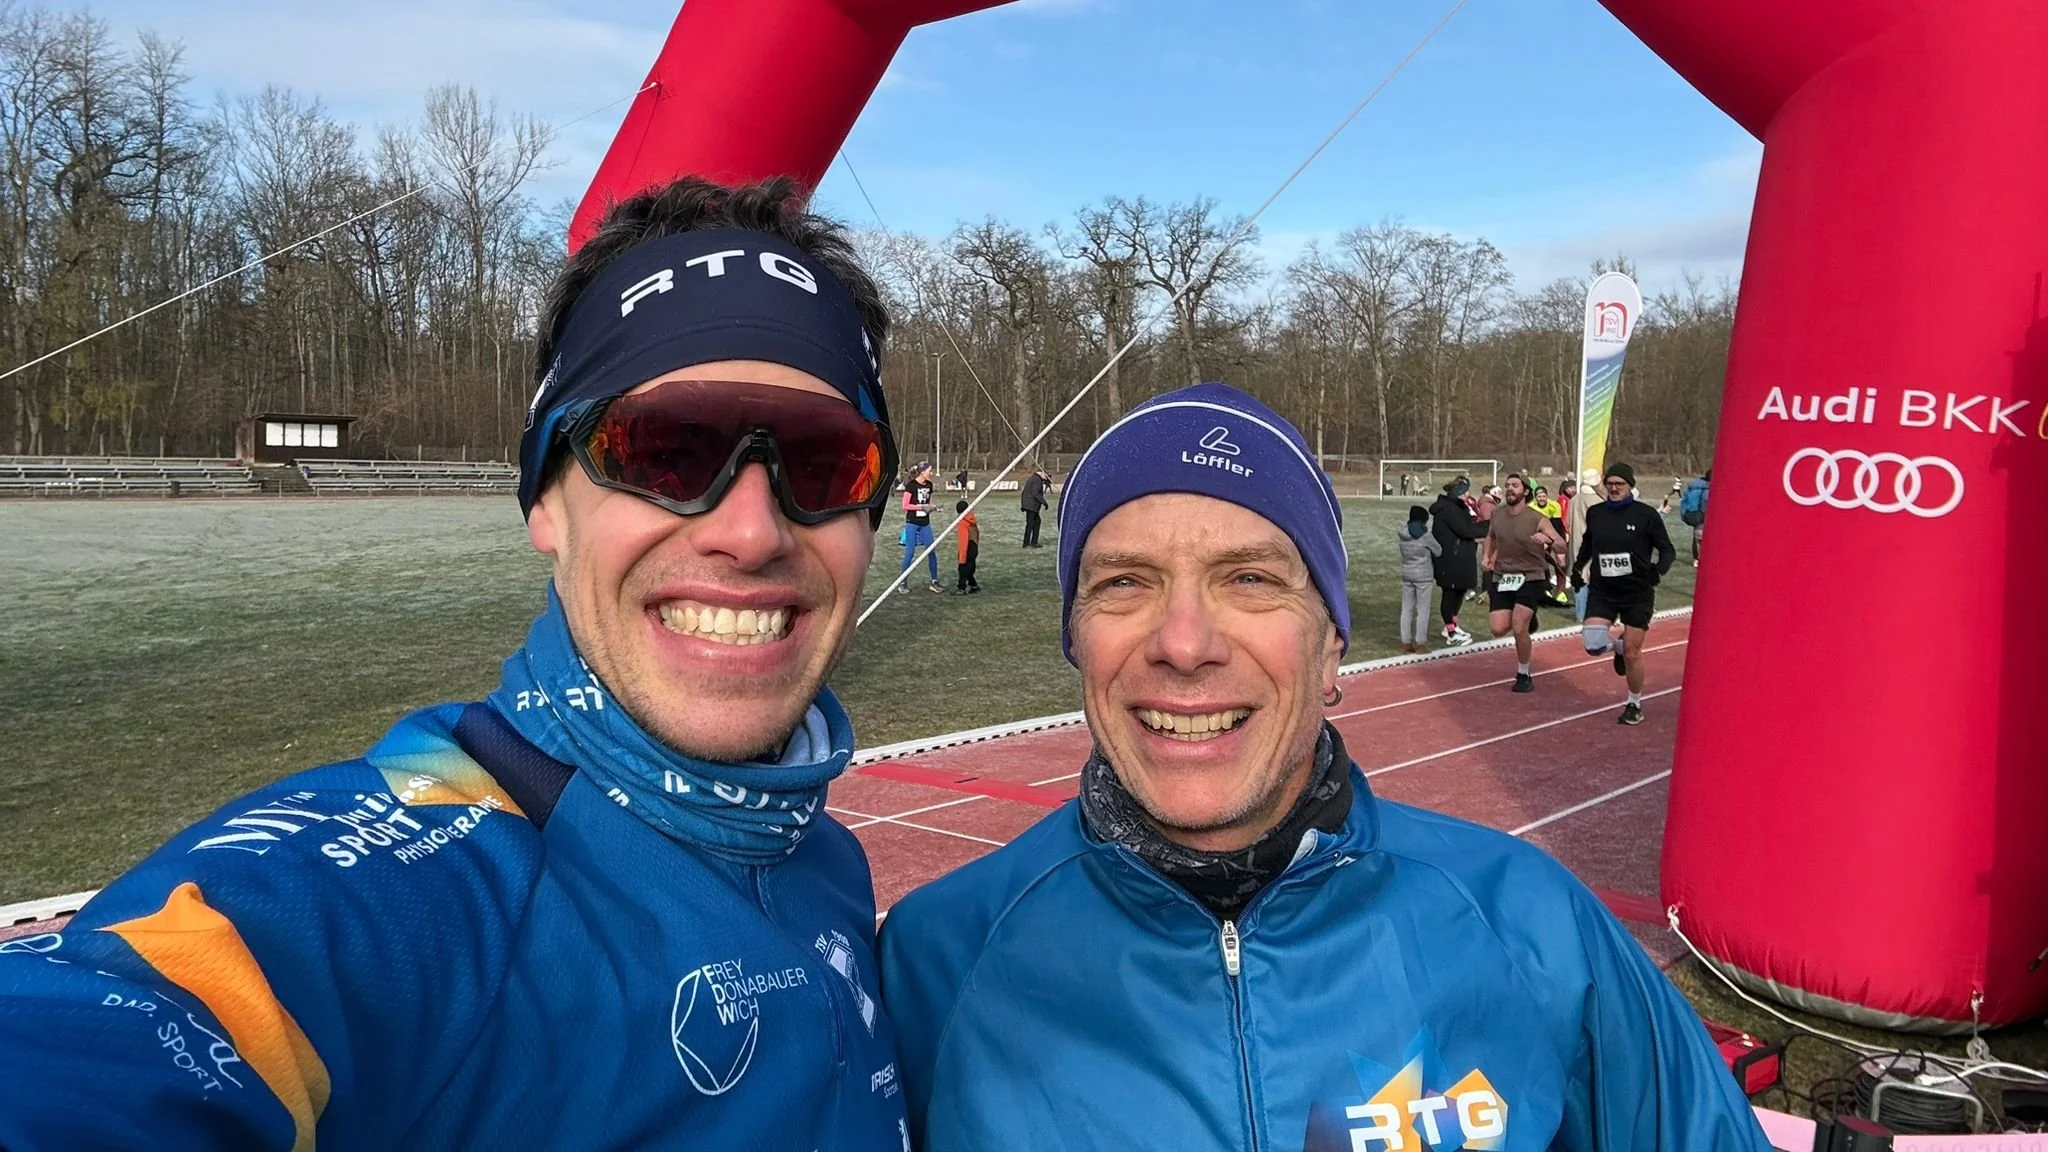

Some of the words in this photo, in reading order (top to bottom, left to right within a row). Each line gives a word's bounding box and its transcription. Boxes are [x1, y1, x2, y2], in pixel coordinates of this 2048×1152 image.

[621, 249, 818, 318] RTG
[1757, 386, 1877, 424] Audi
[1899, 389, 2031, 438] BKK
[1181, 450, 1254, 478] Löffler
[1601, 557, 1629, 568] 5766
[321, 808, 424, 867] SPORT
[701, 958, 744, 985] FREY
[711, 967, 809, 1005] DONABAUER
[716, 997, 760, 1026] WICH
[1345, 1089, 1503, 1152] RTG
